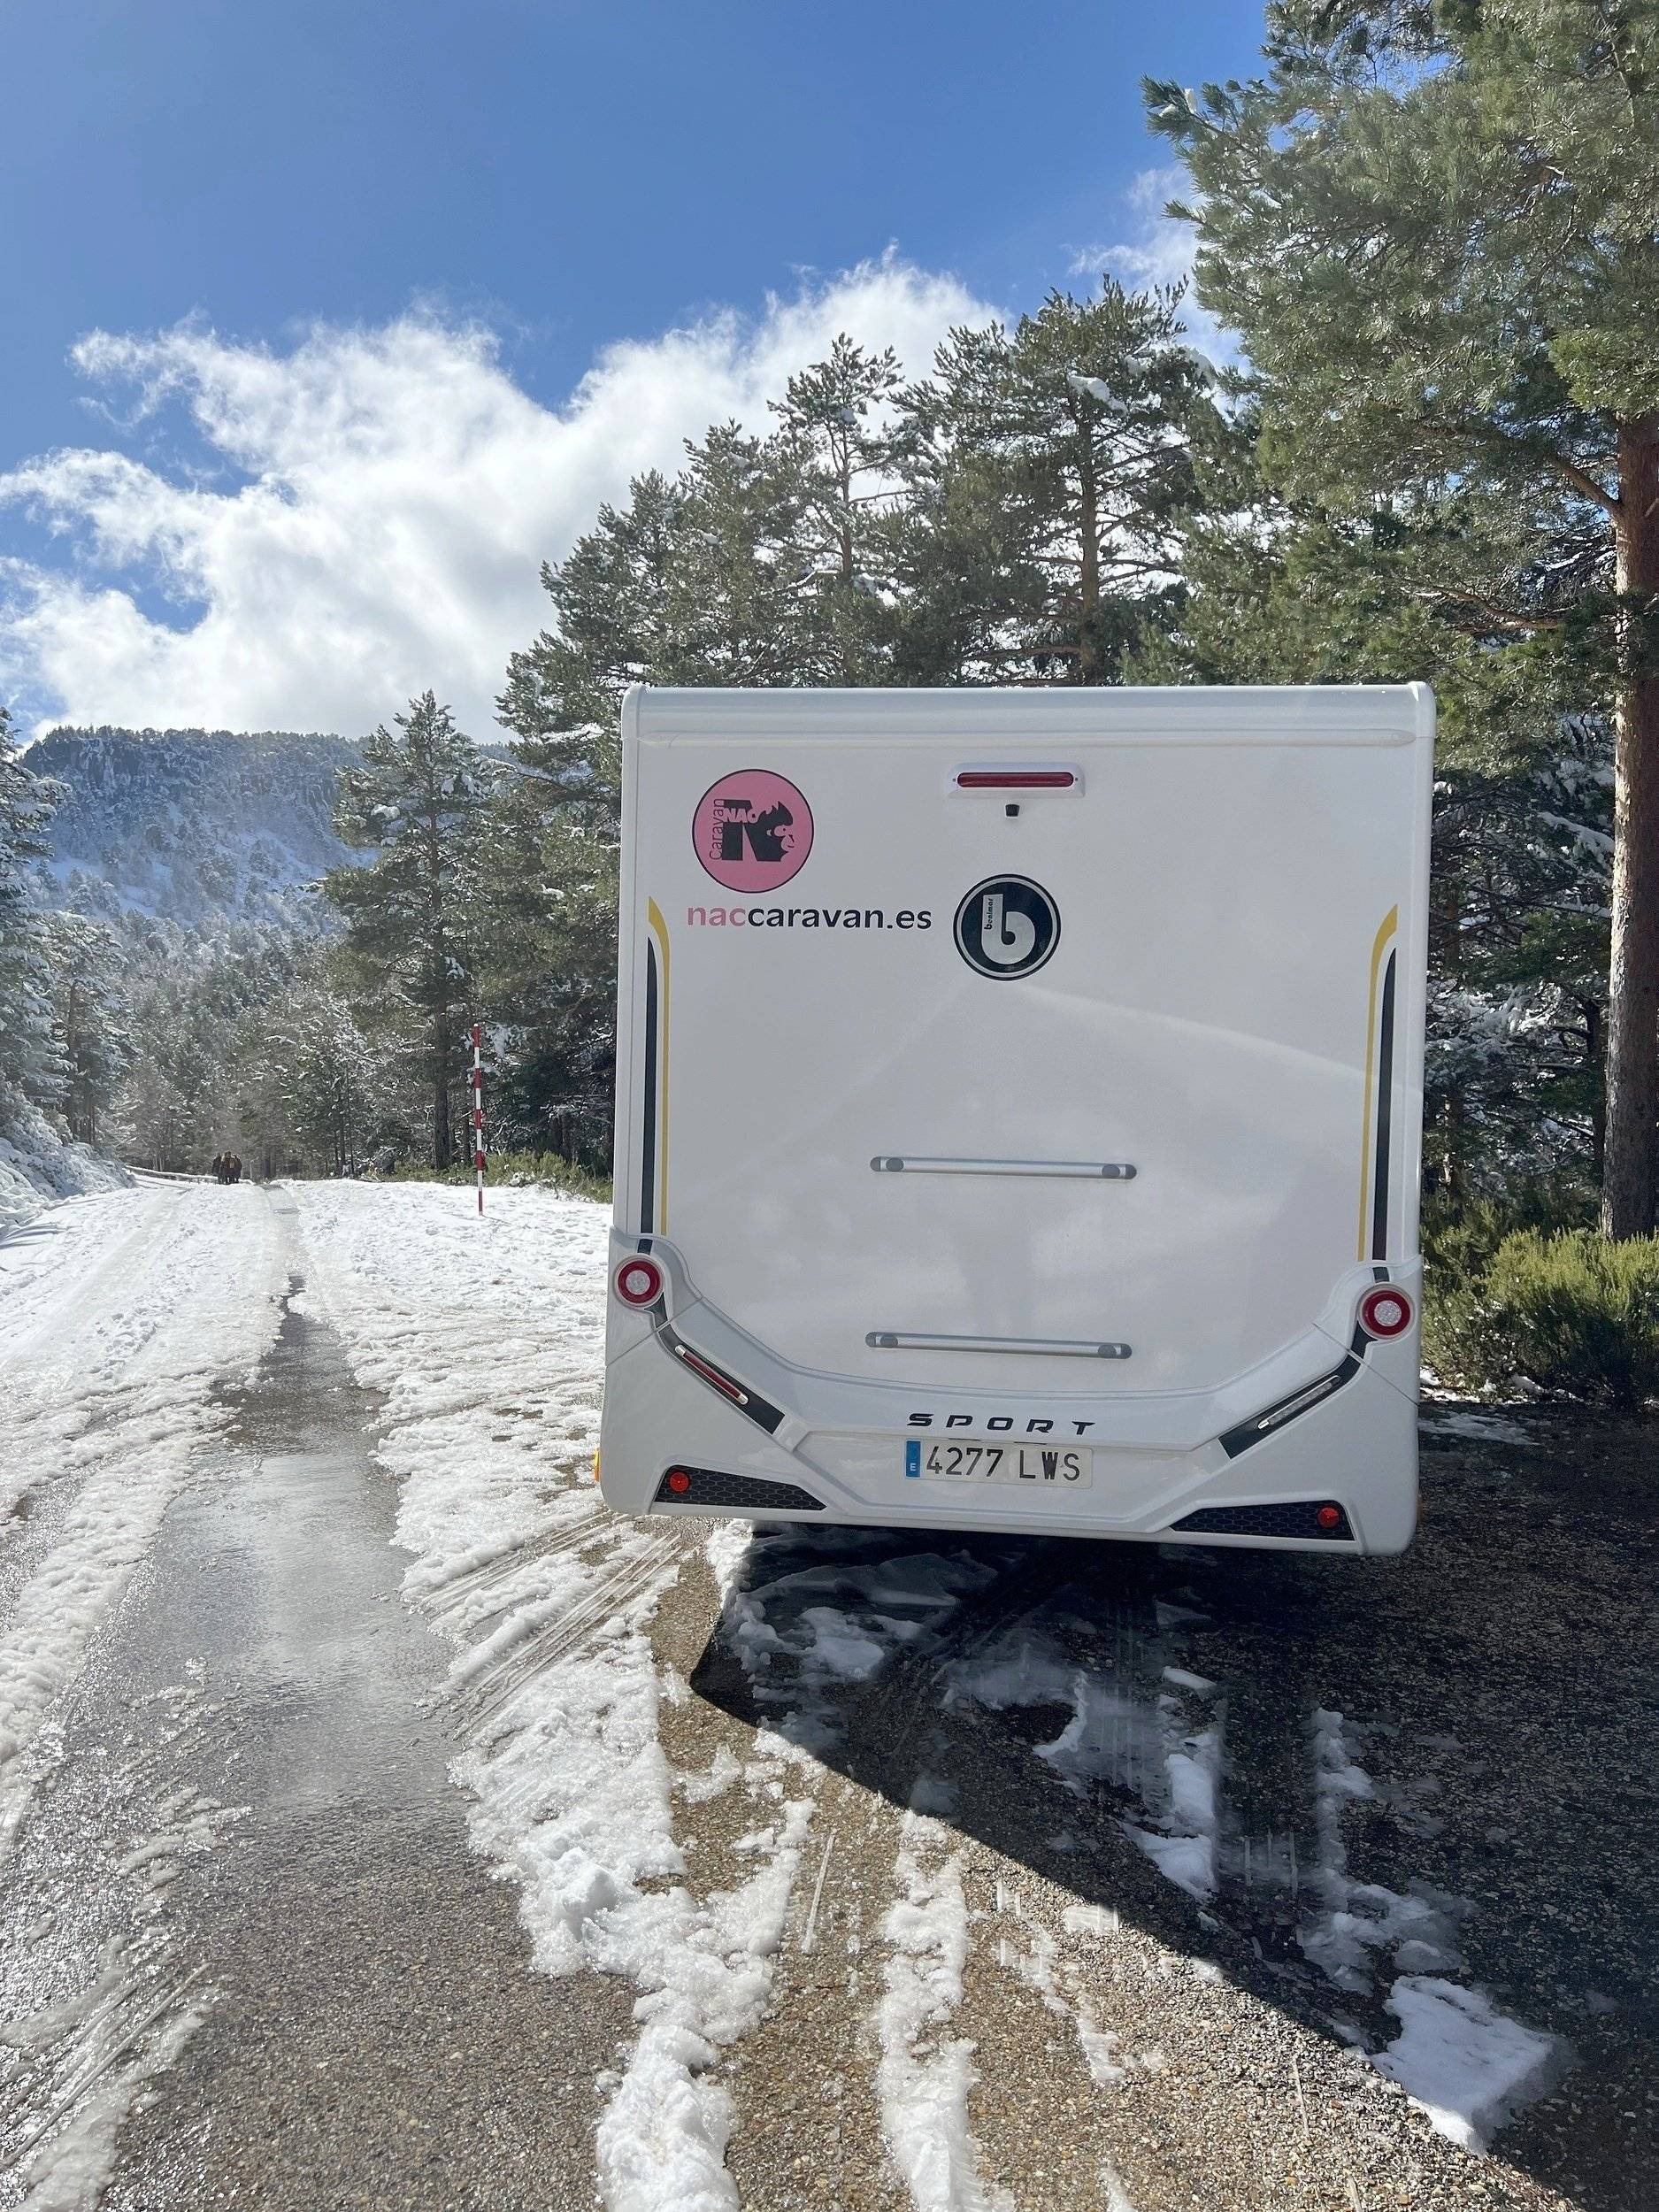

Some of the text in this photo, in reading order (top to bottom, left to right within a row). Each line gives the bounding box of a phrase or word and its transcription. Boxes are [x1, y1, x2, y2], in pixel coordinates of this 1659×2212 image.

[709, 798, 725, 860] Caravan
[687, 906, 932, 929] naccaravan.es
[907, 1413, 1096, 1435] SPORT
[926, 1446, 1080, 1481] 4277 LWS
